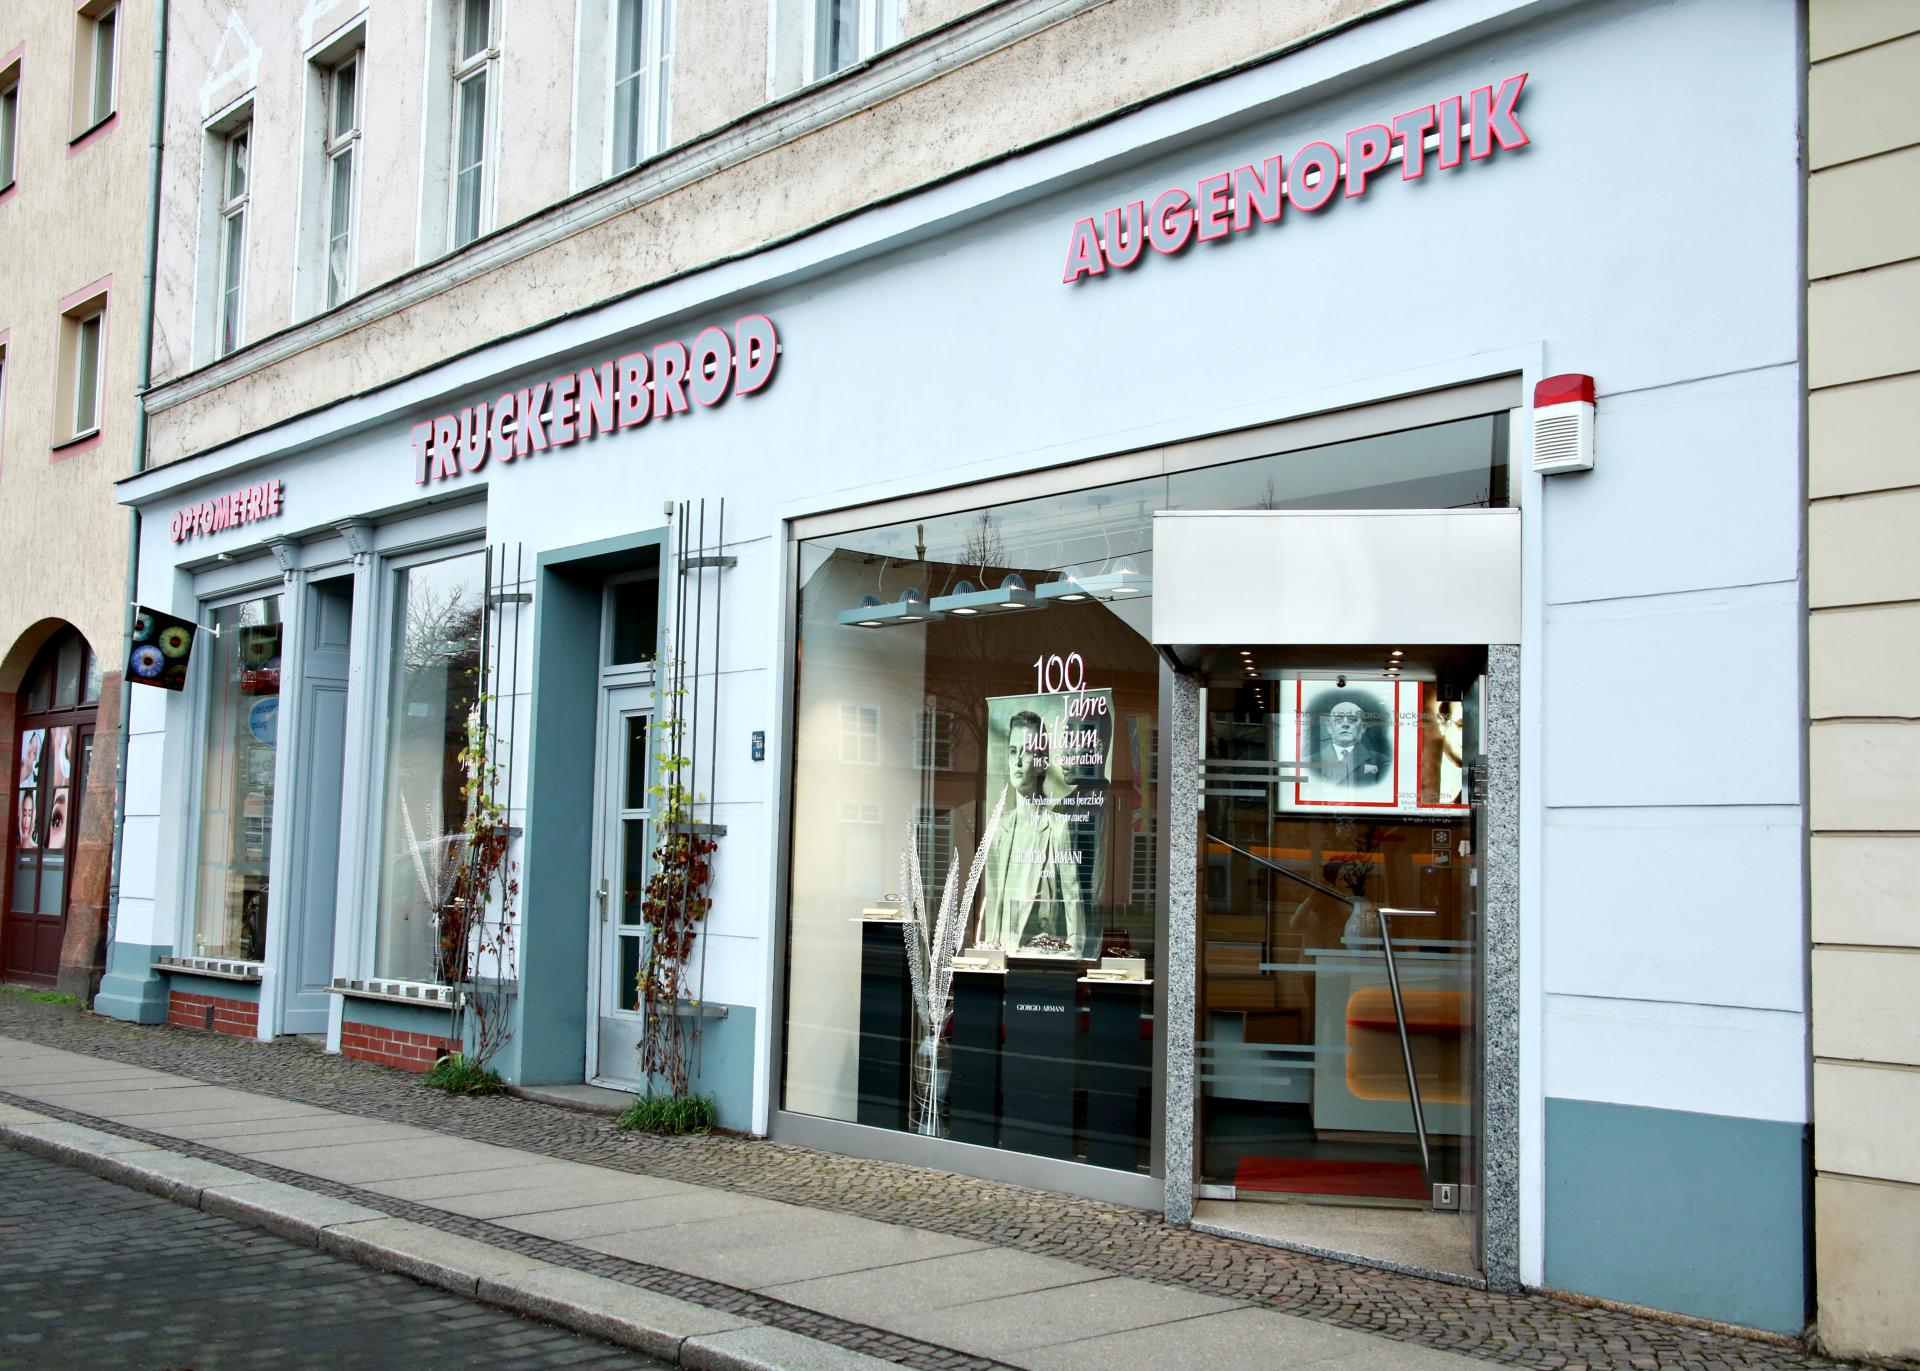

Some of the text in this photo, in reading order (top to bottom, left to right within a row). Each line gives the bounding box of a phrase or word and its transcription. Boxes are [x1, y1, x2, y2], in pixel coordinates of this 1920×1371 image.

[1063, 73, 1530, 283] AUGENOPTIK
[411, 313, 778, 485] TRUCKENBROD
[169, 479, 281, 543] OPTOMETRIE
[1033, 651, 1084, 695] 100
[1061, 682, 1107, 722] Jahre
[1020, 716, 1098, 758] Jubiläum
[1033, 753, 1042, 767] in
[1052, 750, 1103, 767] Generation
[1063, 797, 1076, 806] uns
[1076, 790, 1104, 807] herzlich
[1049, 850, 1082, 865] ARMANI
